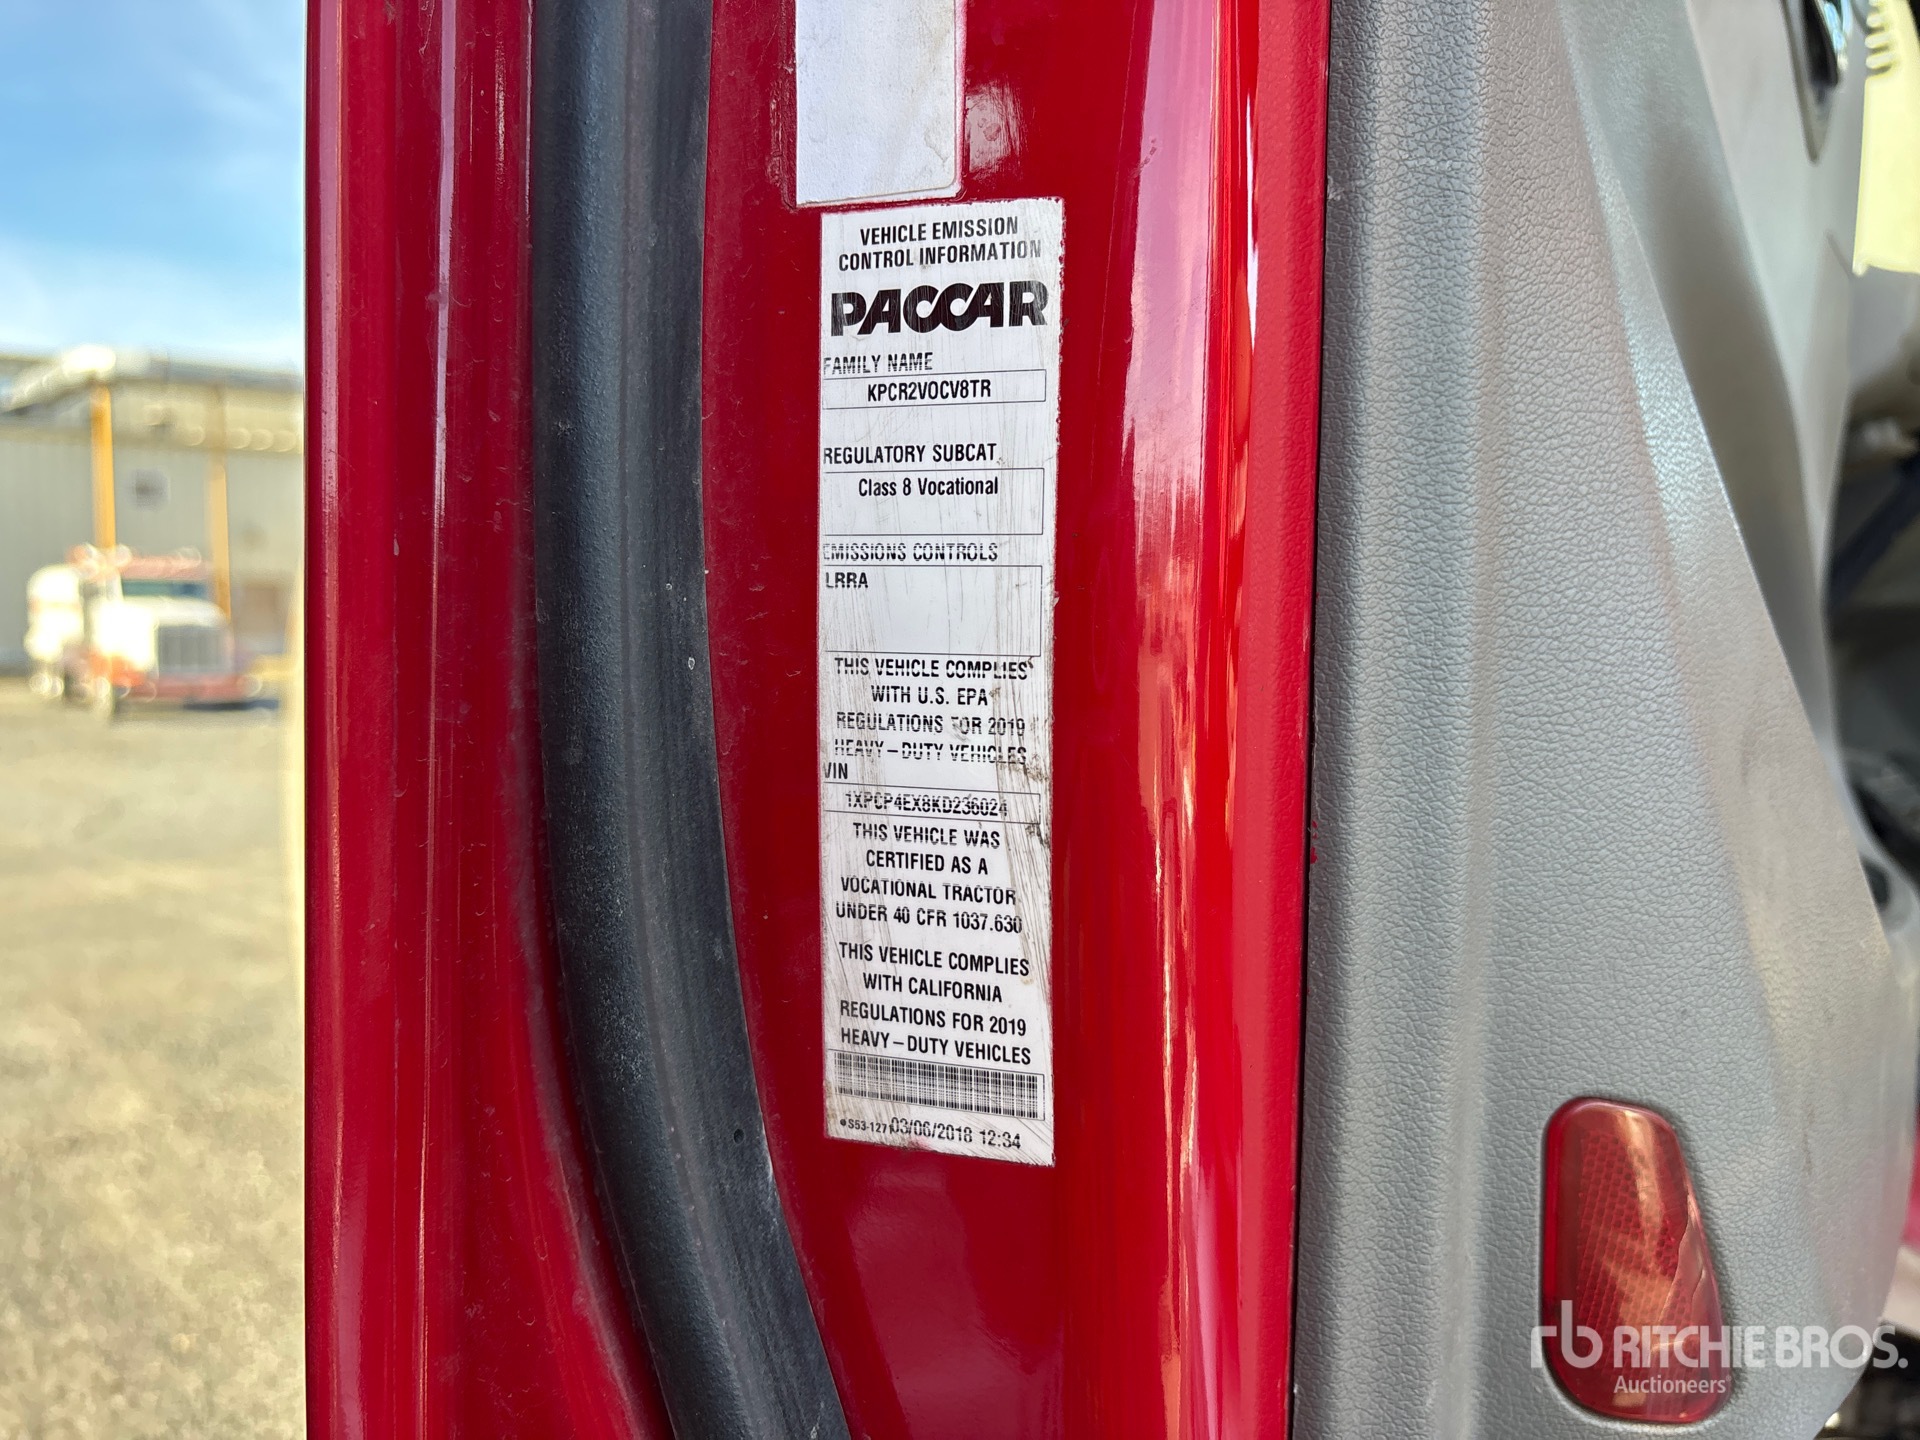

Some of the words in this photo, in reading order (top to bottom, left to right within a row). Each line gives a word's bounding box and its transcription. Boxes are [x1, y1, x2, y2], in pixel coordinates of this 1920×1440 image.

[860, 223, 927, 246] VEHICLE
[932, 216, 1018, 240] EMISSION
[839, 249, 914, 272] CONTROL
[919, 239, 1042, 266] INFORMATION
[831, 280, 1049, 337] PACCAR
[823, 354, 881, 375] FAMILY
[888, 352, 933, 372] NAME
[823, 445, 926, 465] REGULATORY
[932, 443, 997, 462] SUBCAT
[858, 478, 897, 497] Class
[902, 478, 912, 495] 8
[918, 476, 998, 496] Vocational
[823, 543, 906, 561] EMISSIONS
[913, 543, 998, 562] CONTROLS
[826, 572, 869, 588] LRRA
[835, 657, 870, 676] THIS
[875, 658, 940, 678] VEHICLE
[945, 659, 1028, 680] COMPLIES
[871, 685, 911, 703] WITH
[918, 687, 950, 705] U.S.
[957, 688, 988, 706] EPA
[836, 712, 944, 733] REGULATIONS
[988, 717, 1025, 736] 2019
[949, 744, 1027, 764] VEHICLES
[823, 762, 848, 780] VIN
[853, 822, 888, 842] THIS
[893, 825, 958, 846] VEHICLE
[964, 829, 1000, 849] WAS
[866, 849, 944, 872] CERTIFIED
[951, 856, 972, 874] AS
[978, 857, 988, 875] A
[841, 877, 937, 899] VOCATIONAL
[942, 884, 1016, 905] TRACTOR
[835, 902, 888, 922] UNDER
[893, 907, 910, 924] 40
[916, 909, 947, 927] CFR
[953, 911, 1023, 934] 1037.630
[839, 941, 873, 961] THIS
[879, 945, 943, 968] VEHICLE
[949, 952, 1030, 976] COMPLIES
[863, 973, 903, 992] WITH
[909, 977, 1003, 1002] CALIFORNIA
[840, 1000, 946, 1028] REGULATIONS
[952, 1013, 984, 1032] FOR
[989, 1016, 1026, 1037] 2019
[954, 1040, 1031, 1065] VEHICLES
[891, 1117, 973, 1143] 03/06/2018
[979, 1129, 1022, 1149] 12:34
